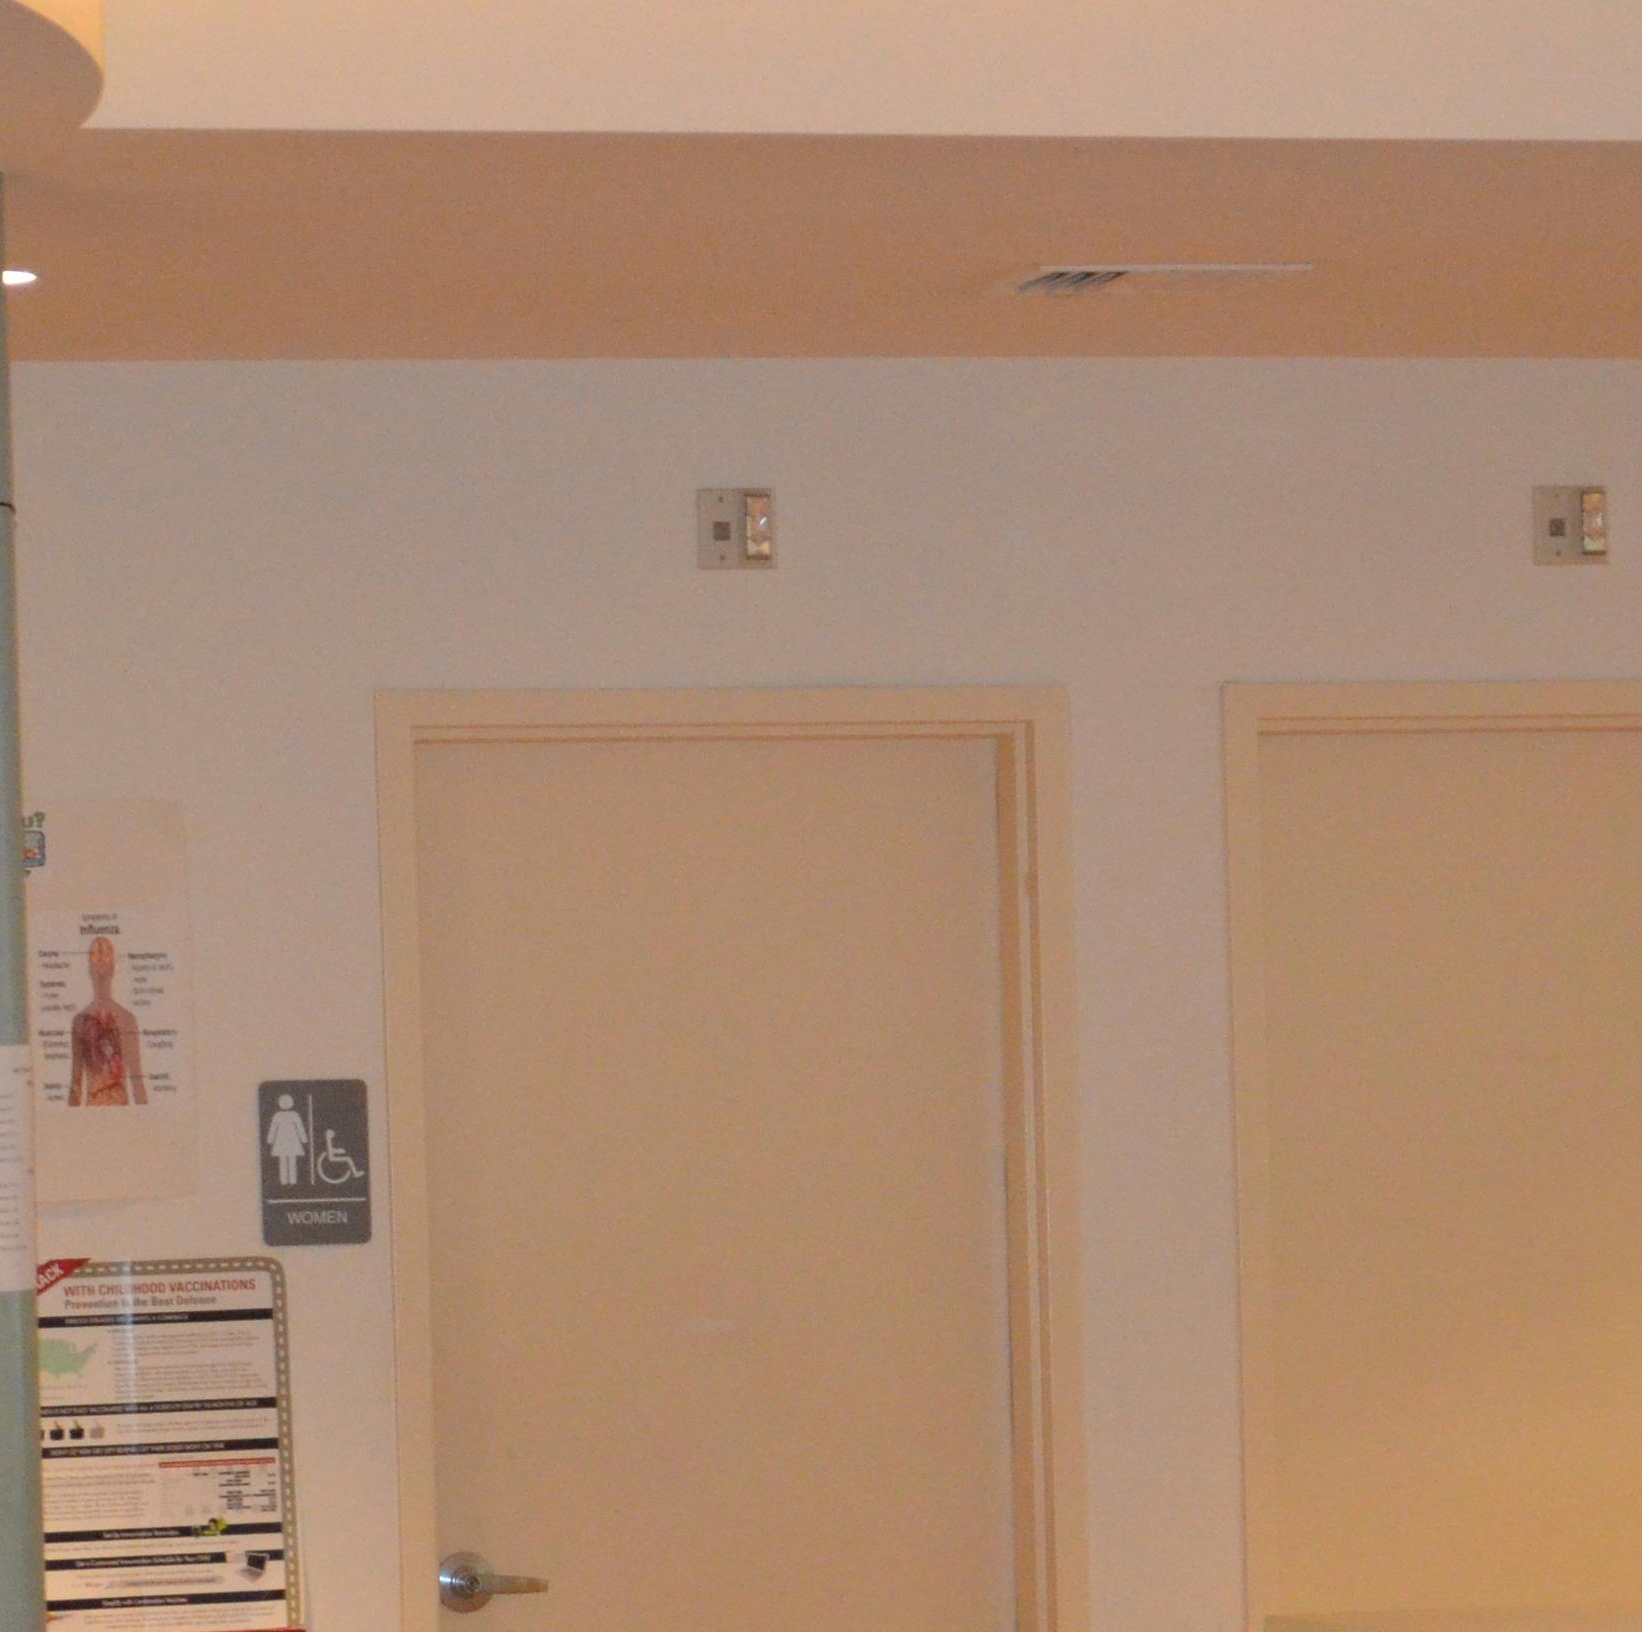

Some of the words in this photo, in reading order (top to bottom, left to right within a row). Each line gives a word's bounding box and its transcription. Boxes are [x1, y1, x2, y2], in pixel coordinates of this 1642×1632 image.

[286, 1210, 348, 1225] WOMEN
[63, 1285, 95, 1296] WITH
[98, 1281, 166, 1296] CHILHOOD
[169, 1278, 256, 1293] VACCINATIONS
